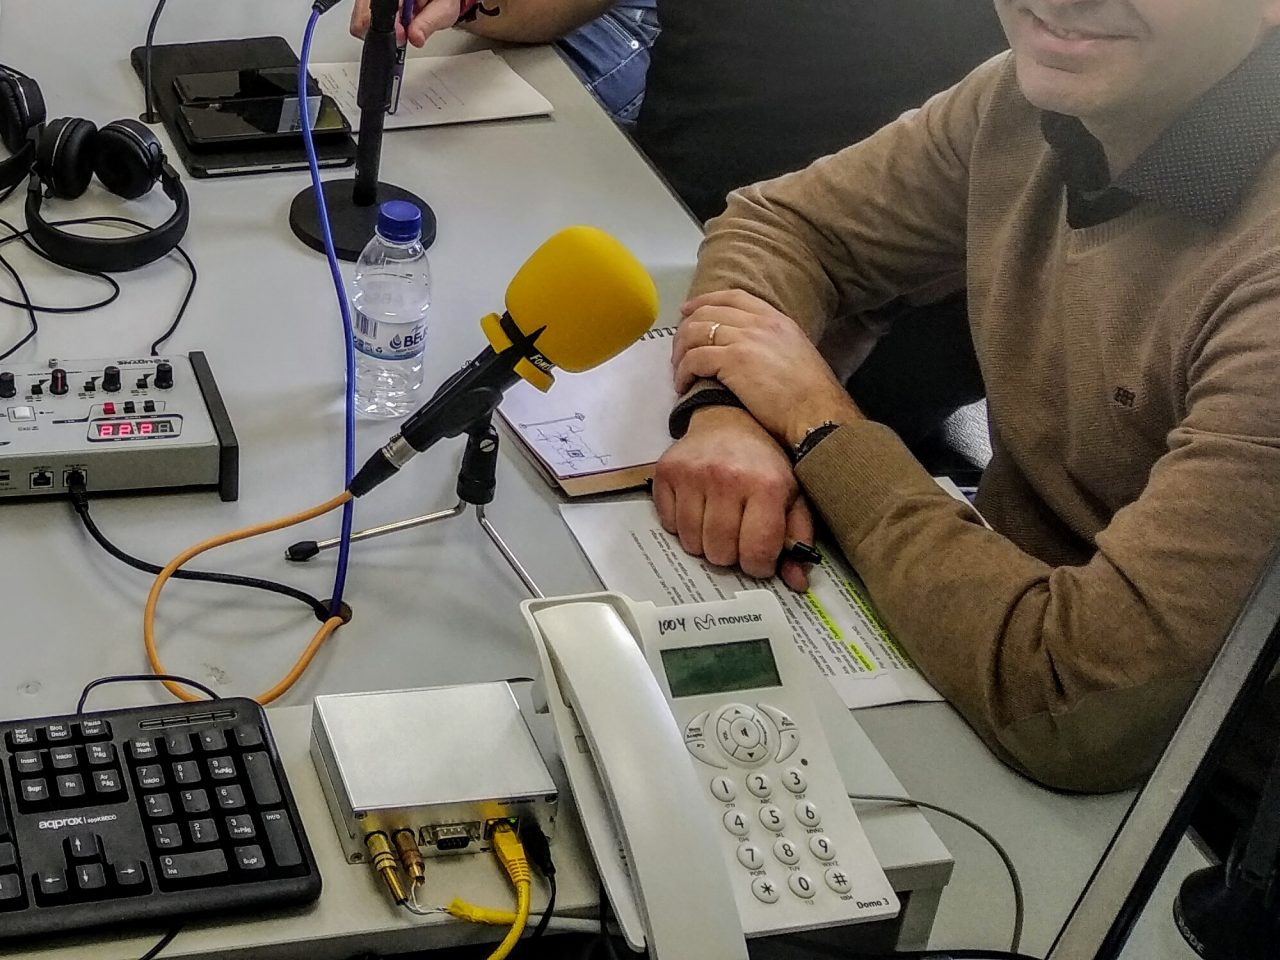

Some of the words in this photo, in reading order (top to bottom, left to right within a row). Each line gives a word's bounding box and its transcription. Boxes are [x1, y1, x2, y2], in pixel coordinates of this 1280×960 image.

[718, 613, 763, 626] movistar
[755, 776, 767, 790] 2
[790, 772, 800, 786] 3
[770, 810, 780, 824] 5
[805, 806, 815, 820] 6
[734, 815, 744, 829] 4
[782, 843, 794, 858] 8
[818, 839, 828, 853] 9
[745, 848, 755, 862] 7
[856, 899, 880, 909] Domo
[881, 897, 890, 906] 3
